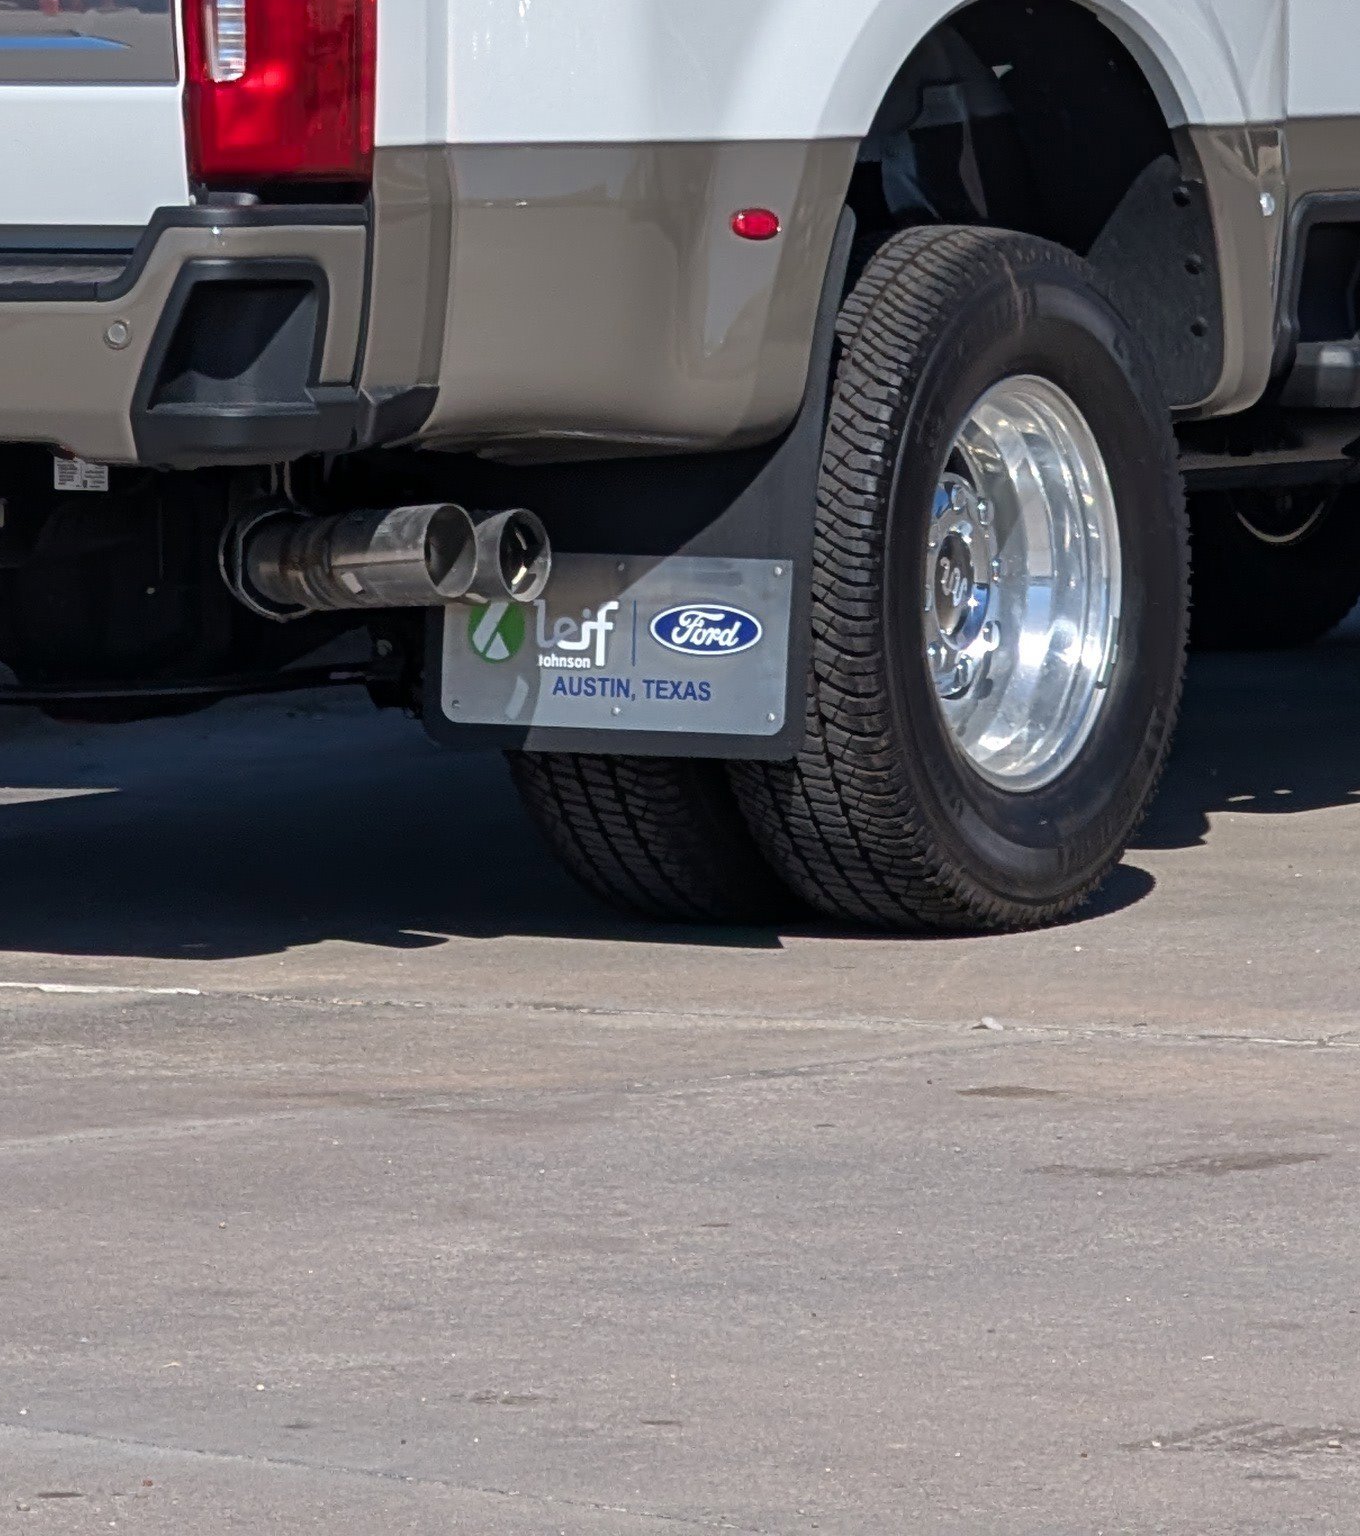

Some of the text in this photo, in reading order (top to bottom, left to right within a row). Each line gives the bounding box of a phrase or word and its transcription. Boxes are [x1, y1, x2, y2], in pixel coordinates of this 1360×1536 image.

[671, 611, 742, 648] Ford
[552, 675, 712, 702] AUSTIN, TEXAS
